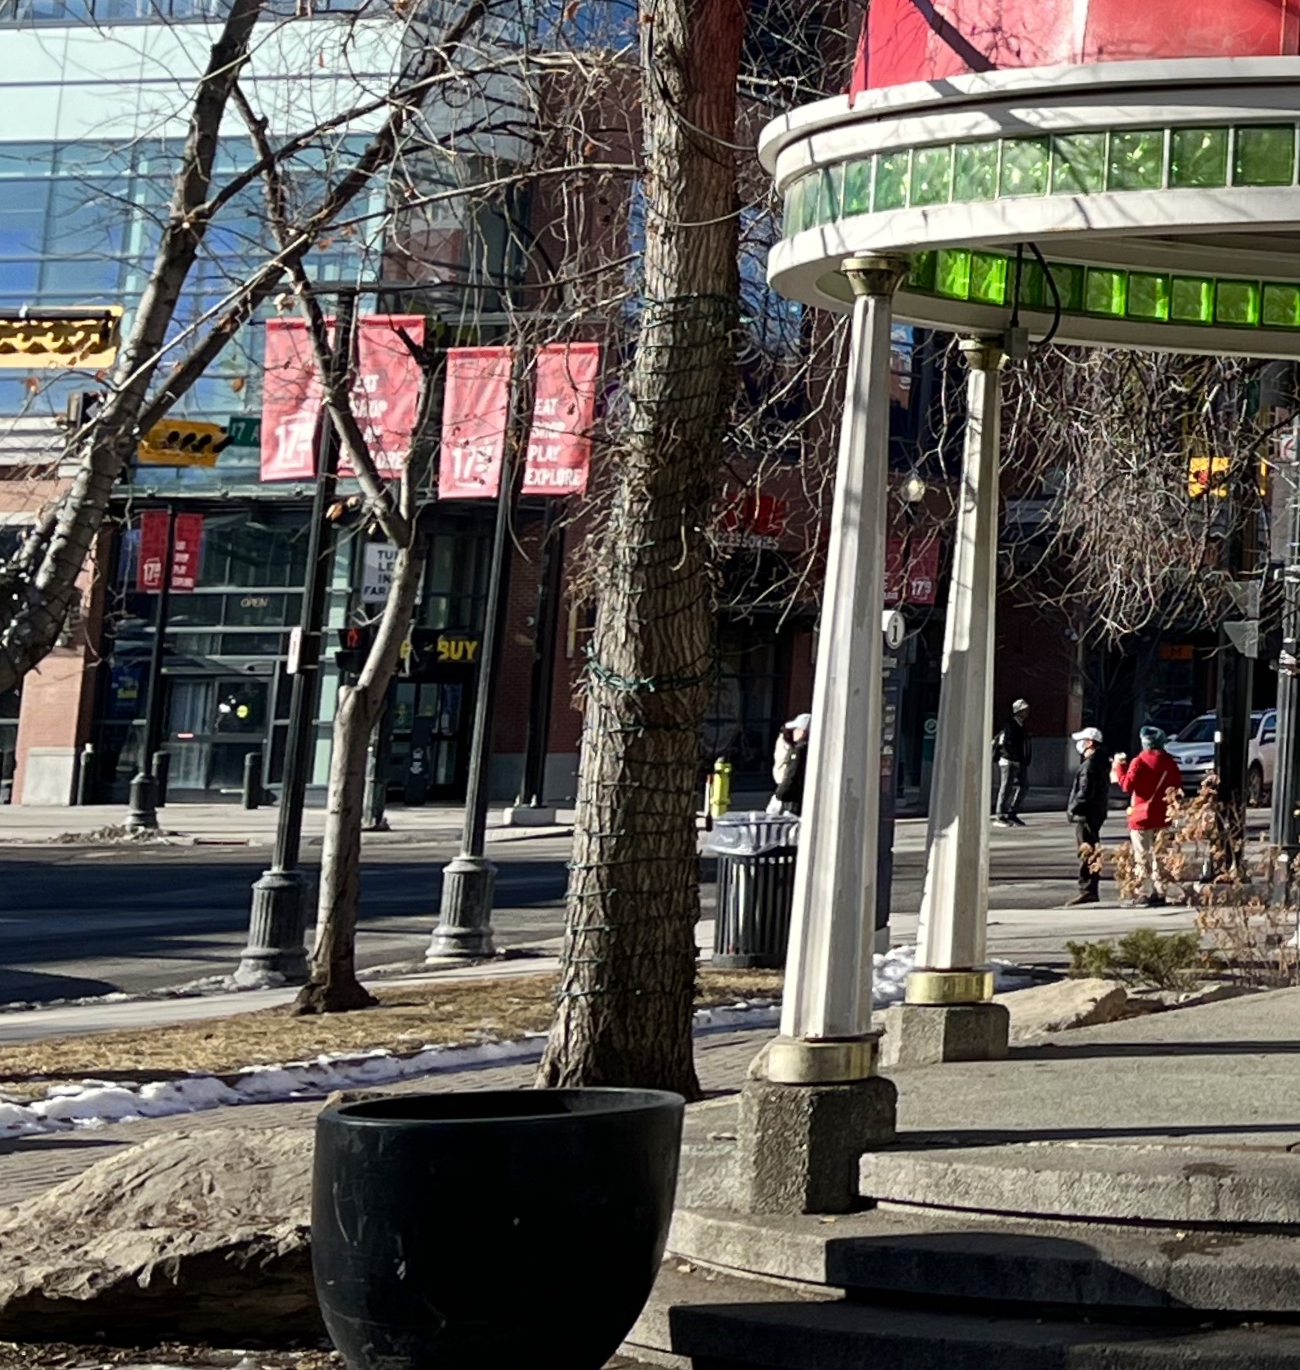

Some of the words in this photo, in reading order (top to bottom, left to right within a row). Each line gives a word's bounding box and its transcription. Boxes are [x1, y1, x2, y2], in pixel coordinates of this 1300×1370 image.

[534, 398, 558, 416] EAT
[527, 445, 561, 463] PLAY
[525, 468, 582, 487] EXPLORE
[437, 639, 478, 661] BUY
